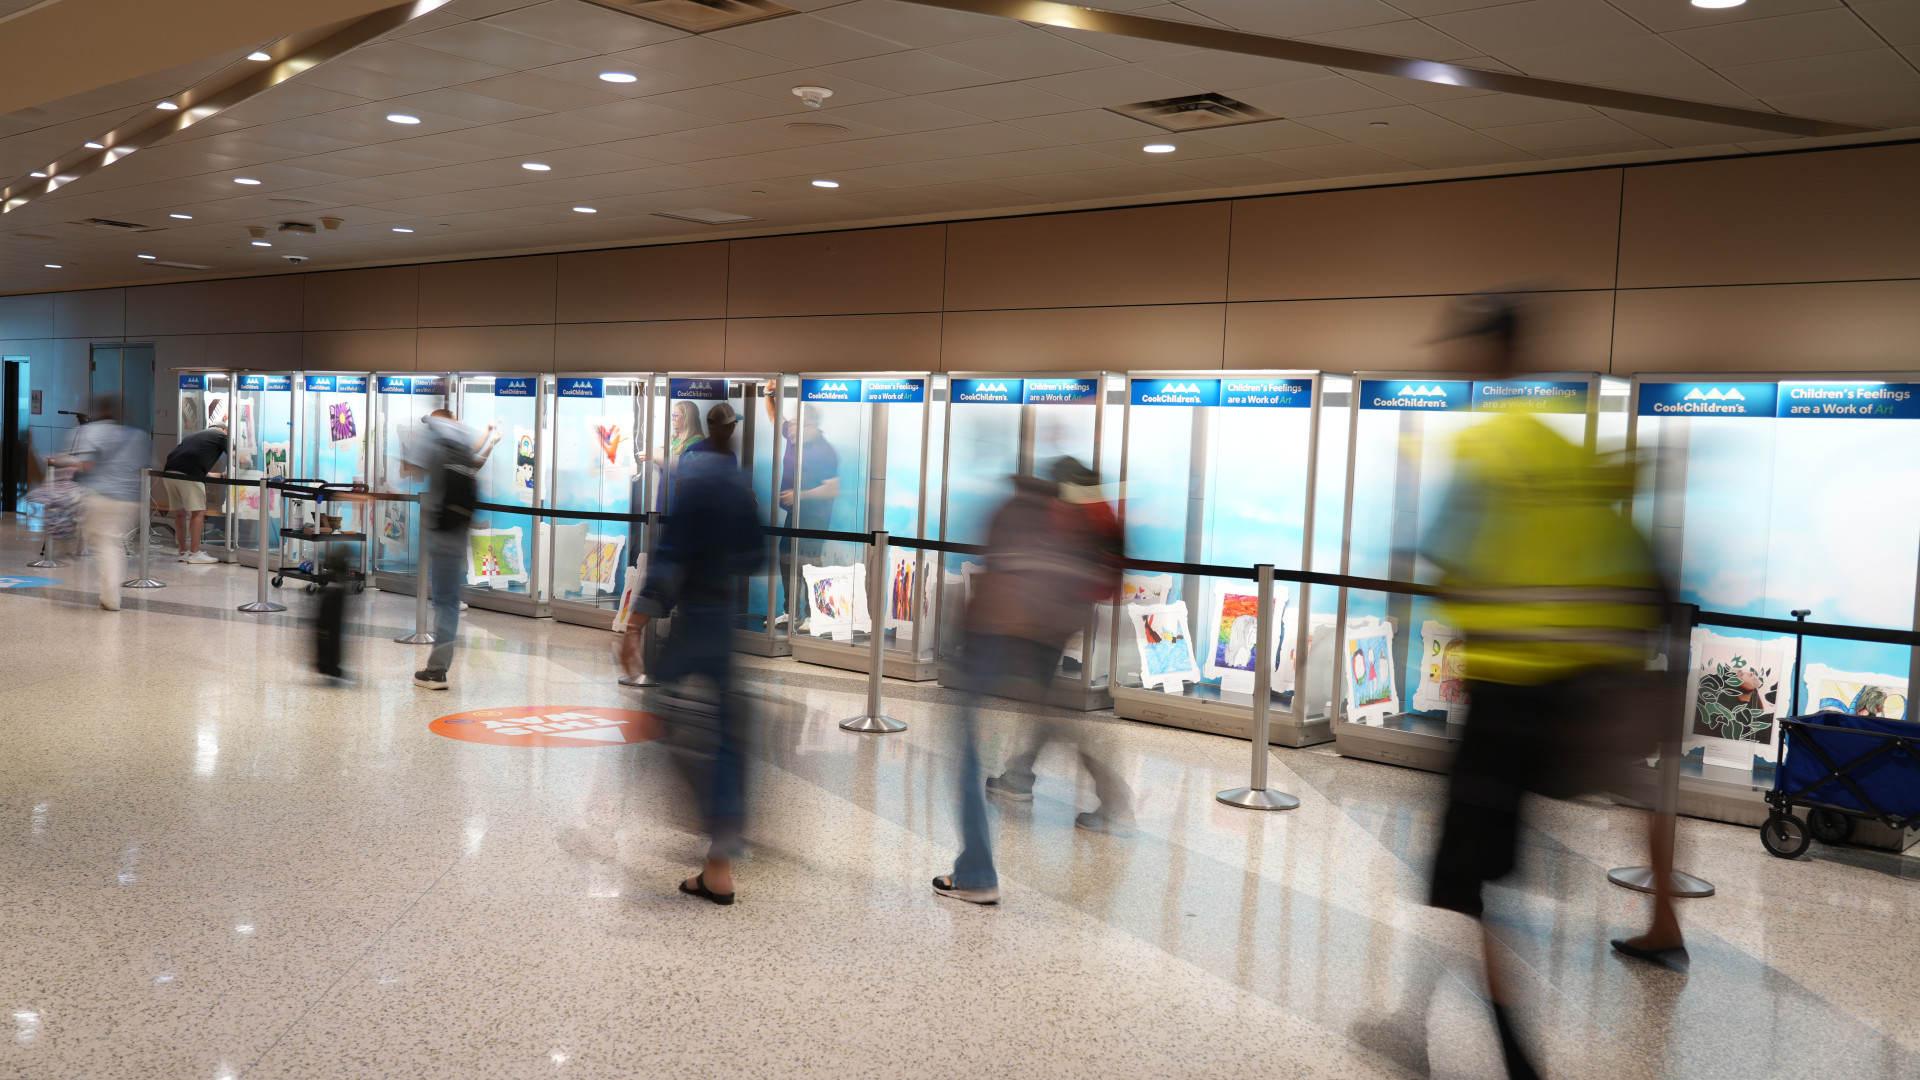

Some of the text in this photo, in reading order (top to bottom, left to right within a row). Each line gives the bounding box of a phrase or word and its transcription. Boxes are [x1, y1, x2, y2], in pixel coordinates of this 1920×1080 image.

[897, 383, 919, 391] Feelings
[1063, 383, 1090, 392] Feelings
[1269, 384, 1302, 393] Feelings
[1482, 386, 1576, 398] Children's Feelings
[1790, 388, 1910, 401] Children's Feelings
[1508, 400, 1534, 408] Work
[1536, 400, 1547, 408] of
[1823, 404, 1856, 414] Work
[1859, 404, 1873, 414] of
[1874, 404, 1894, 414] Art
[480, 712, 600, 729] WAY
[494, 718, 630, 736] THIS
